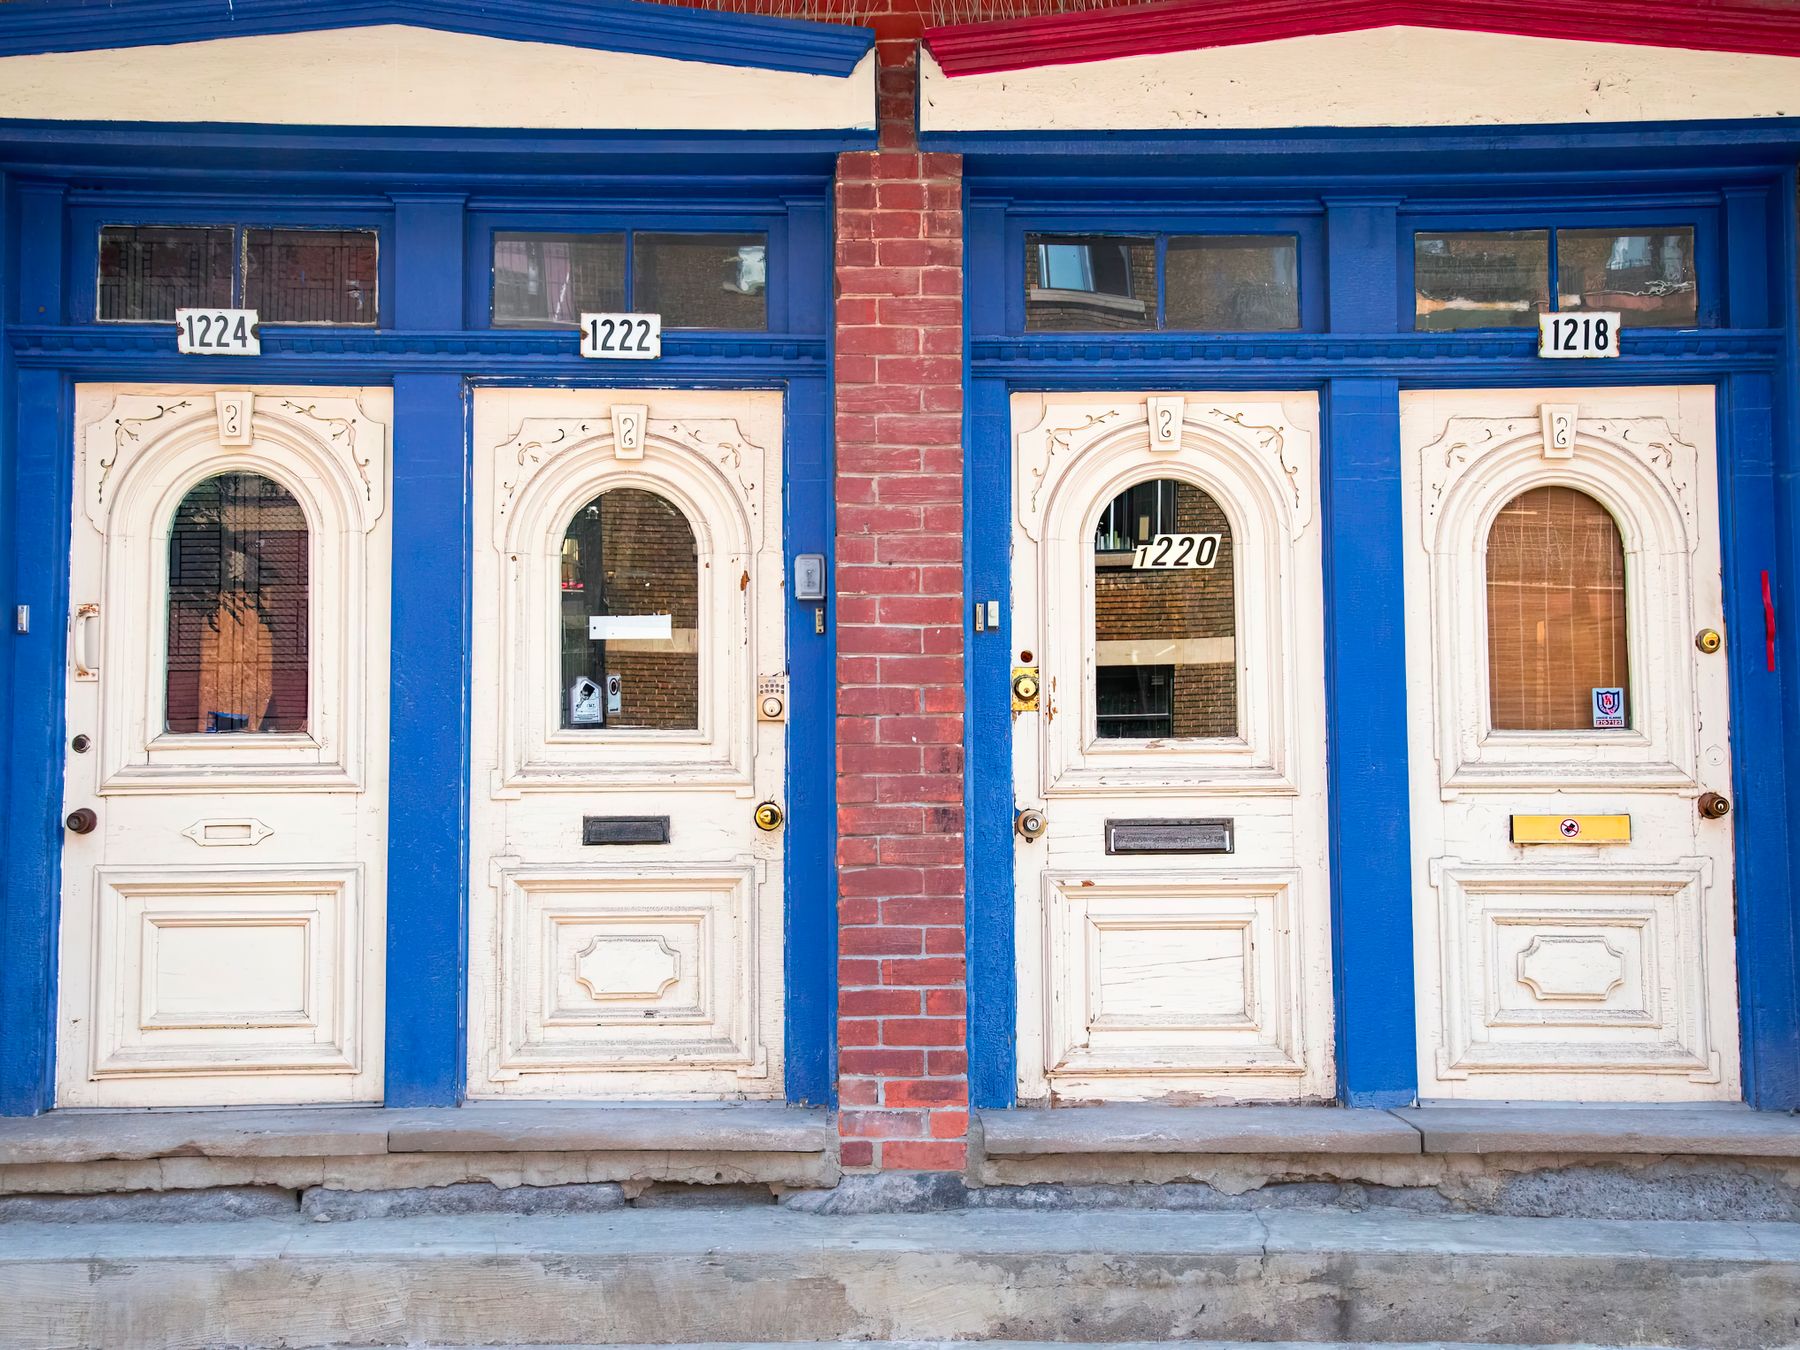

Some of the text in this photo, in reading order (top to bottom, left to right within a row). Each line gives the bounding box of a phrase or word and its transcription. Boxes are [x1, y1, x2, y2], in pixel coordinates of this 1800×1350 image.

[186, 315, 247, 348] 1224
[590, 319, 651, 351] 1222
[1553, 318, 1608, 350] 1218
[1140, 536, 1217, 567] 1220
